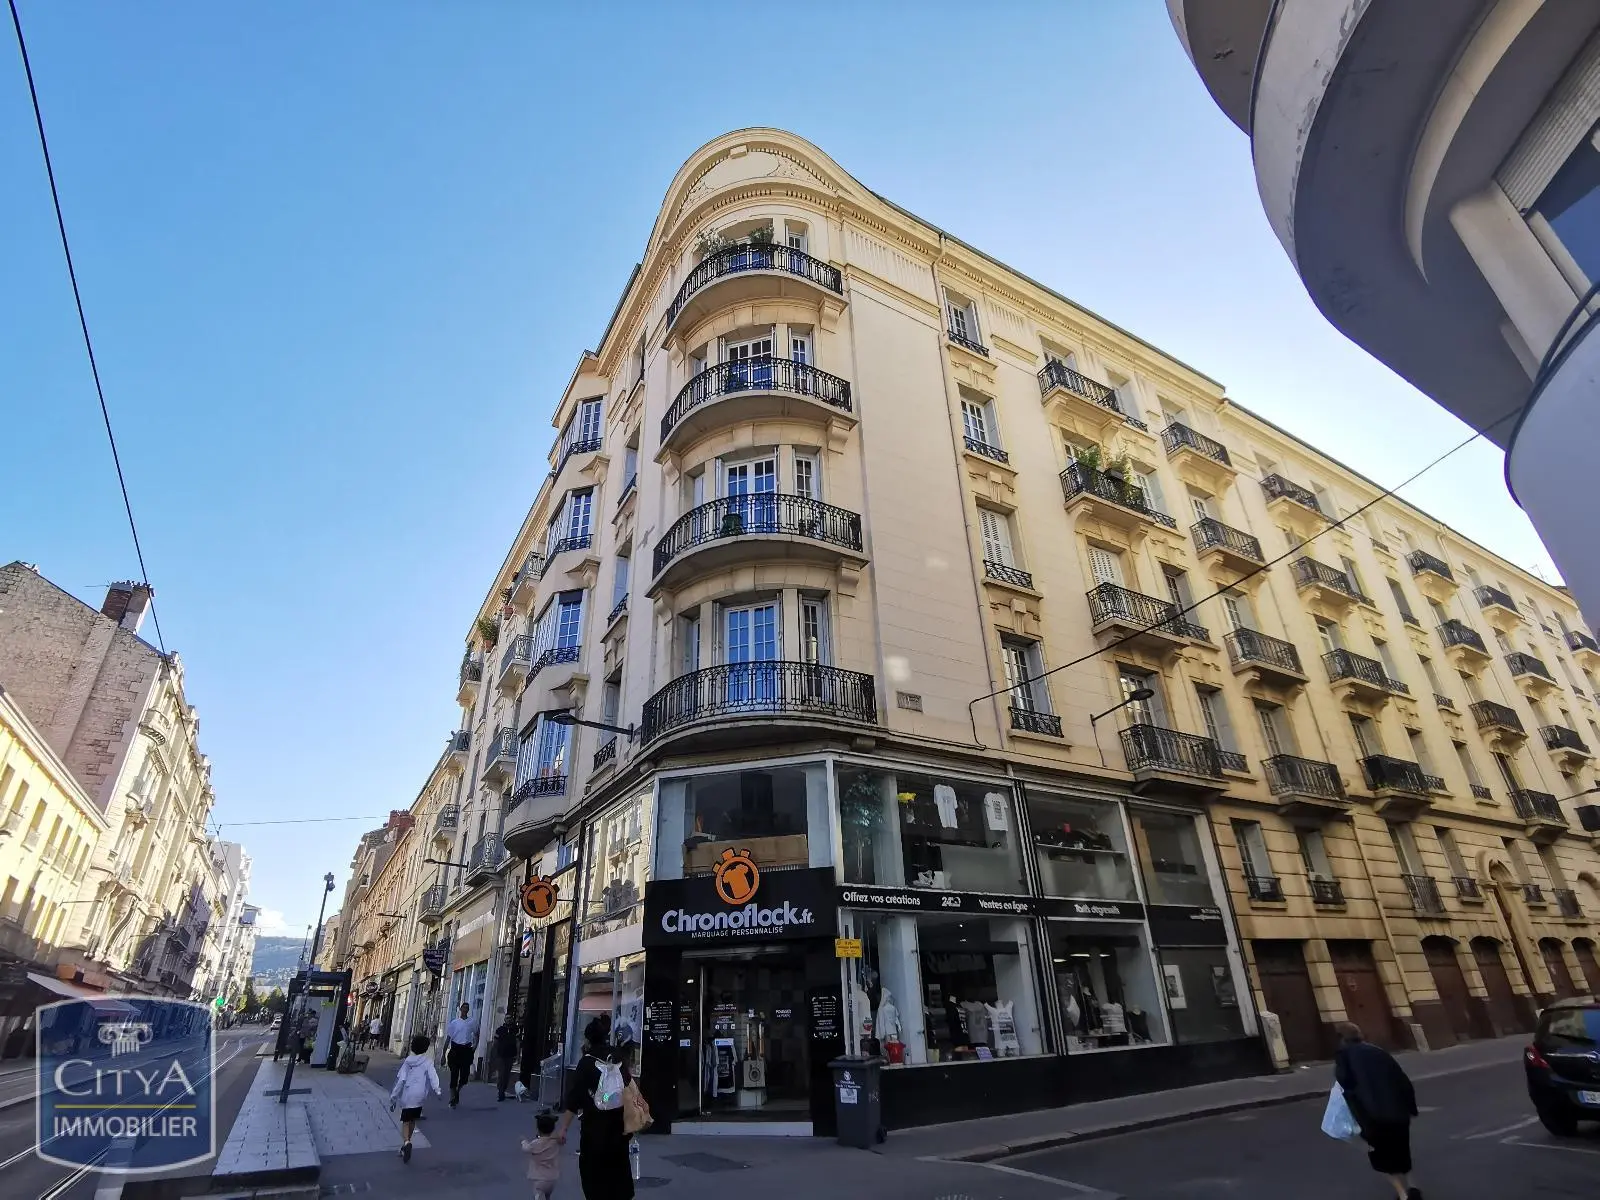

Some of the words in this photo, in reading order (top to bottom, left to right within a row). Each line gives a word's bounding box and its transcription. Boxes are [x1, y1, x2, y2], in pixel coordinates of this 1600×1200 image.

[843, 891, 869, 903] Offrez
[870, 895, 884, 904] vos
[978, 899, 1003, 910] Ventes
[1004, 902, 1012, 910] en
[1012, 900, 1029, 913] ligne
[661, 900, 813, 934] Chronoflock.fr
[691, 928, 729, 939] MARQUAGE
[731, 926, 784, 937] PERSONNALISÉ
